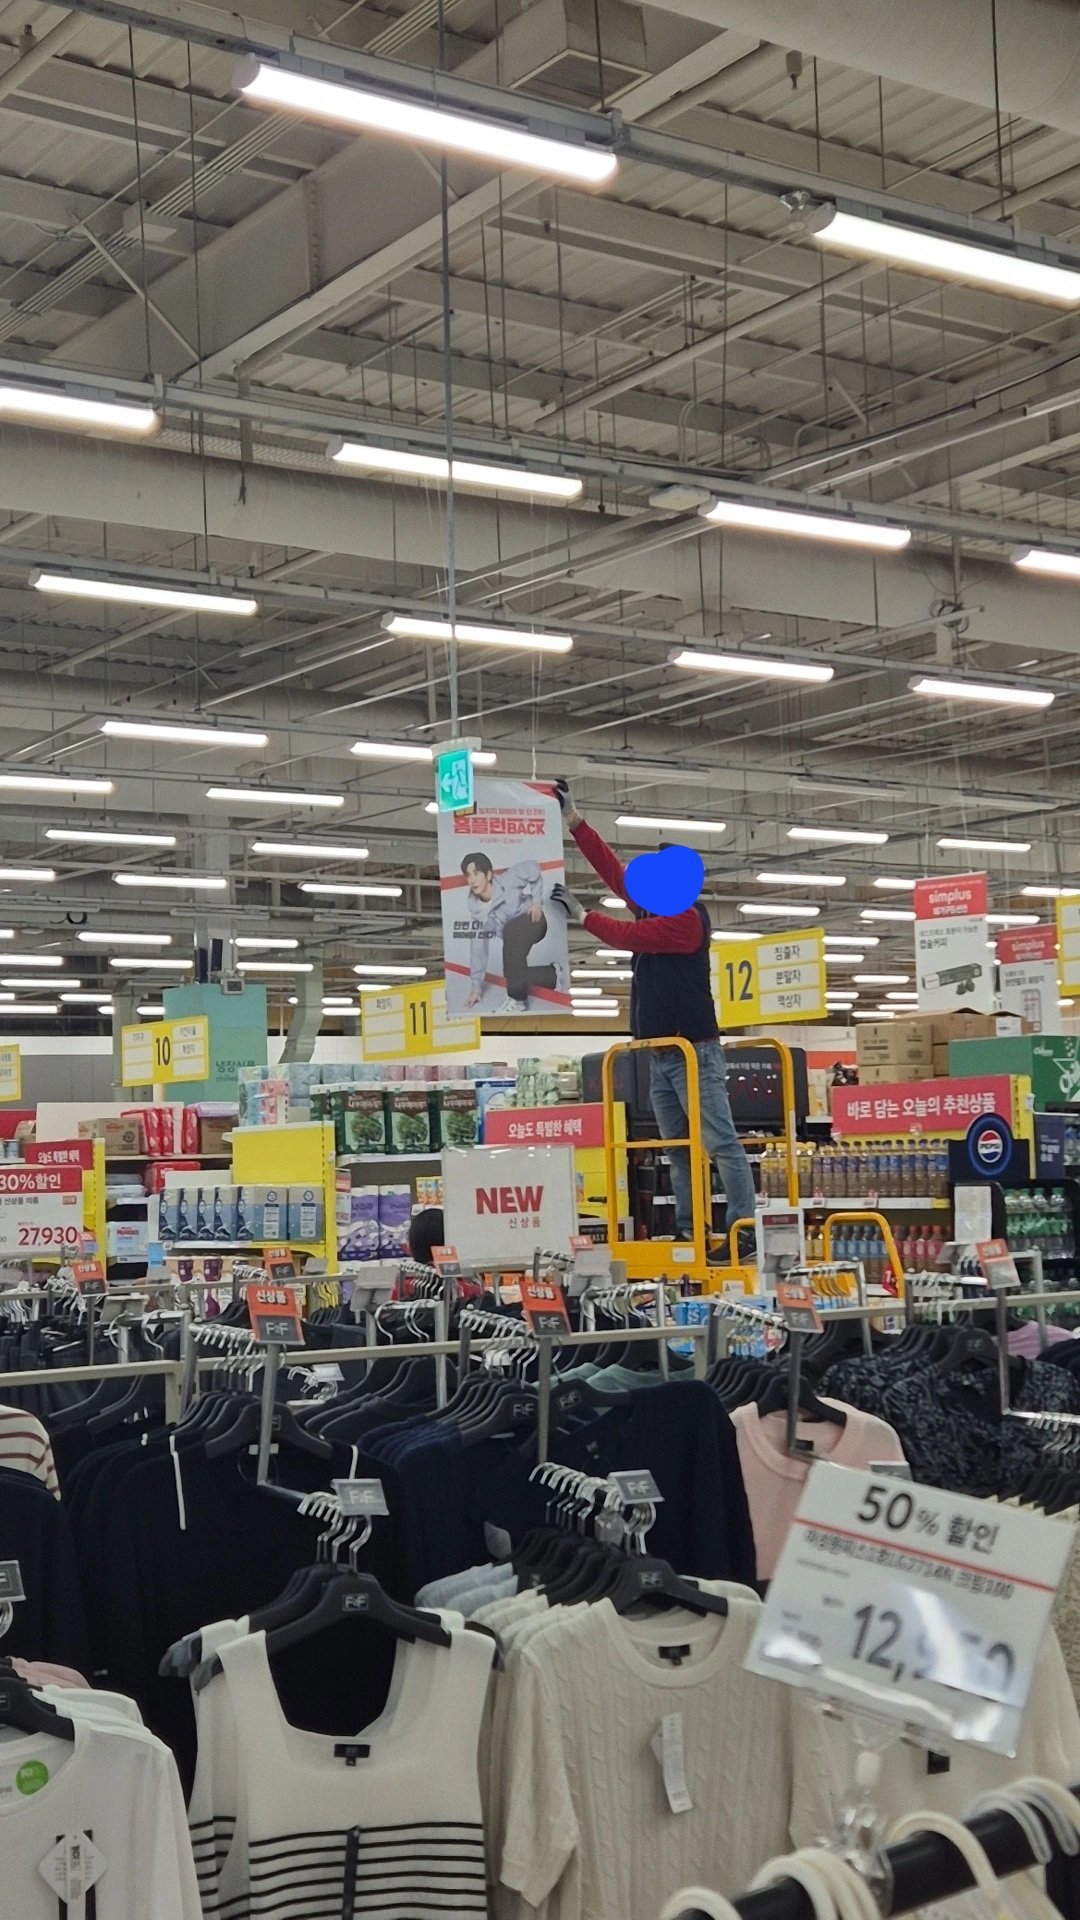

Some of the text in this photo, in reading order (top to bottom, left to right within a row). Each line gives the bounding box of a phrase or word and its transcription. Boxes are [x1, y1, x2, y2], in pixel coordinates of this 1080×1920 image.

[929, 888, 972, 904] simplus
[725, 960, 753, 1002] 12
[776, 969, 801, 985] 분말차
[409, 1001, 428, 1036] 11
[156, 1036, 171, 1066] 10
[847, 1092, 995, 1120] 바로 담는 오늘의 추천상품
[508, 1118, 582, 1139] 오늘도 특별한 혜택
[476, 1186, 544, 1214] NEW
[509, 1216, 541, 1229] 신상품
[256, 1290, 287, 1305] 신상품
[856, 1485, 940, 1537] 50%
[947, 1513, 1000, 1556] 할인
